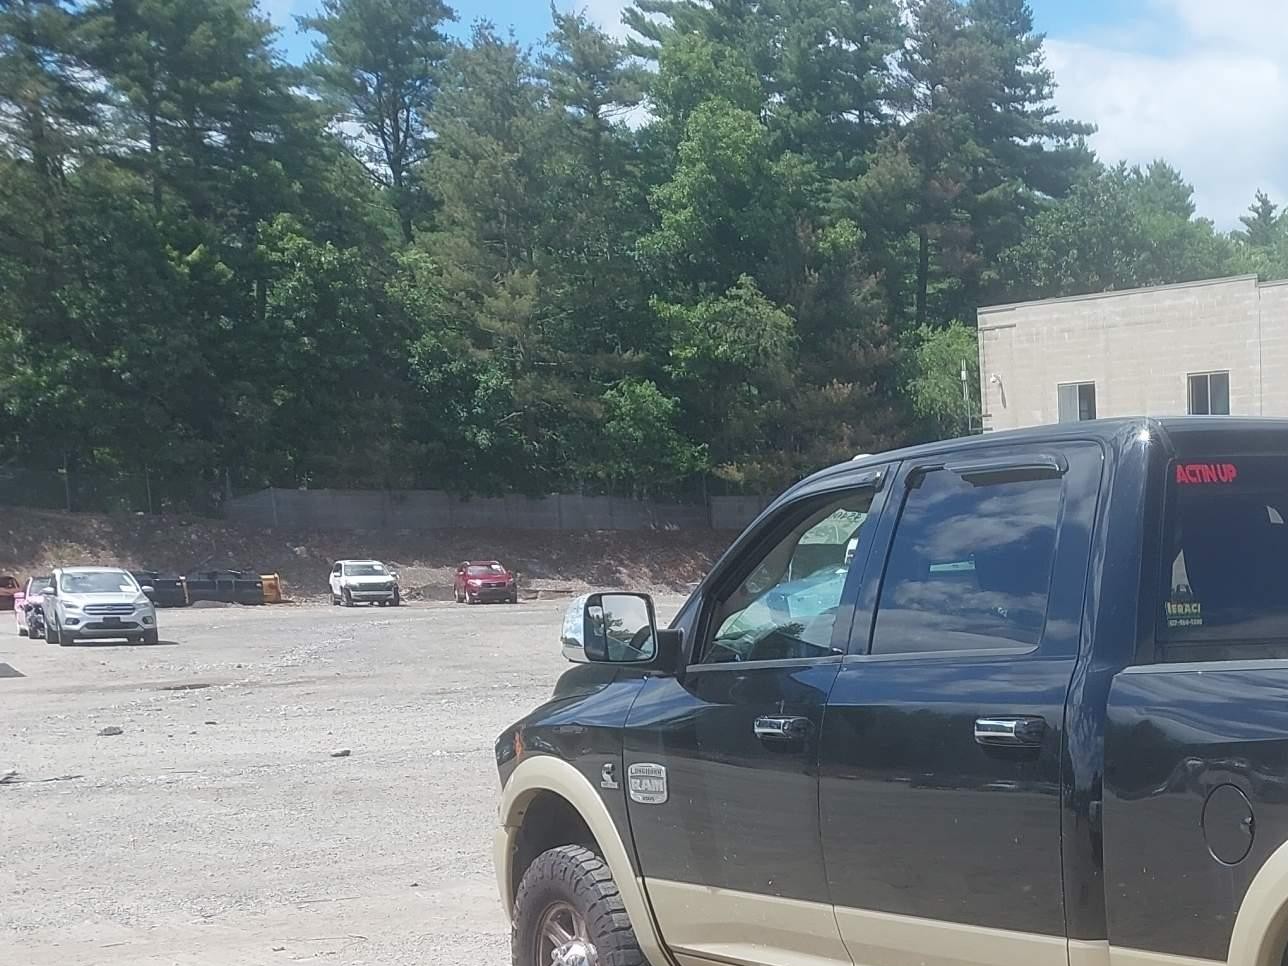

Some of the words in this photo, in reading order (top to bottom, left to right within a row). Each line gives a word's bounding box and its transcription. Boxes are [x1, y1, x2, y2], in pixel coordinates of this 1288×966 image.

[1176, 464, 1217, 483] ACTIN
[1217, 463, 1237, 482] UP
[631, 778, 664, 793] RAM
